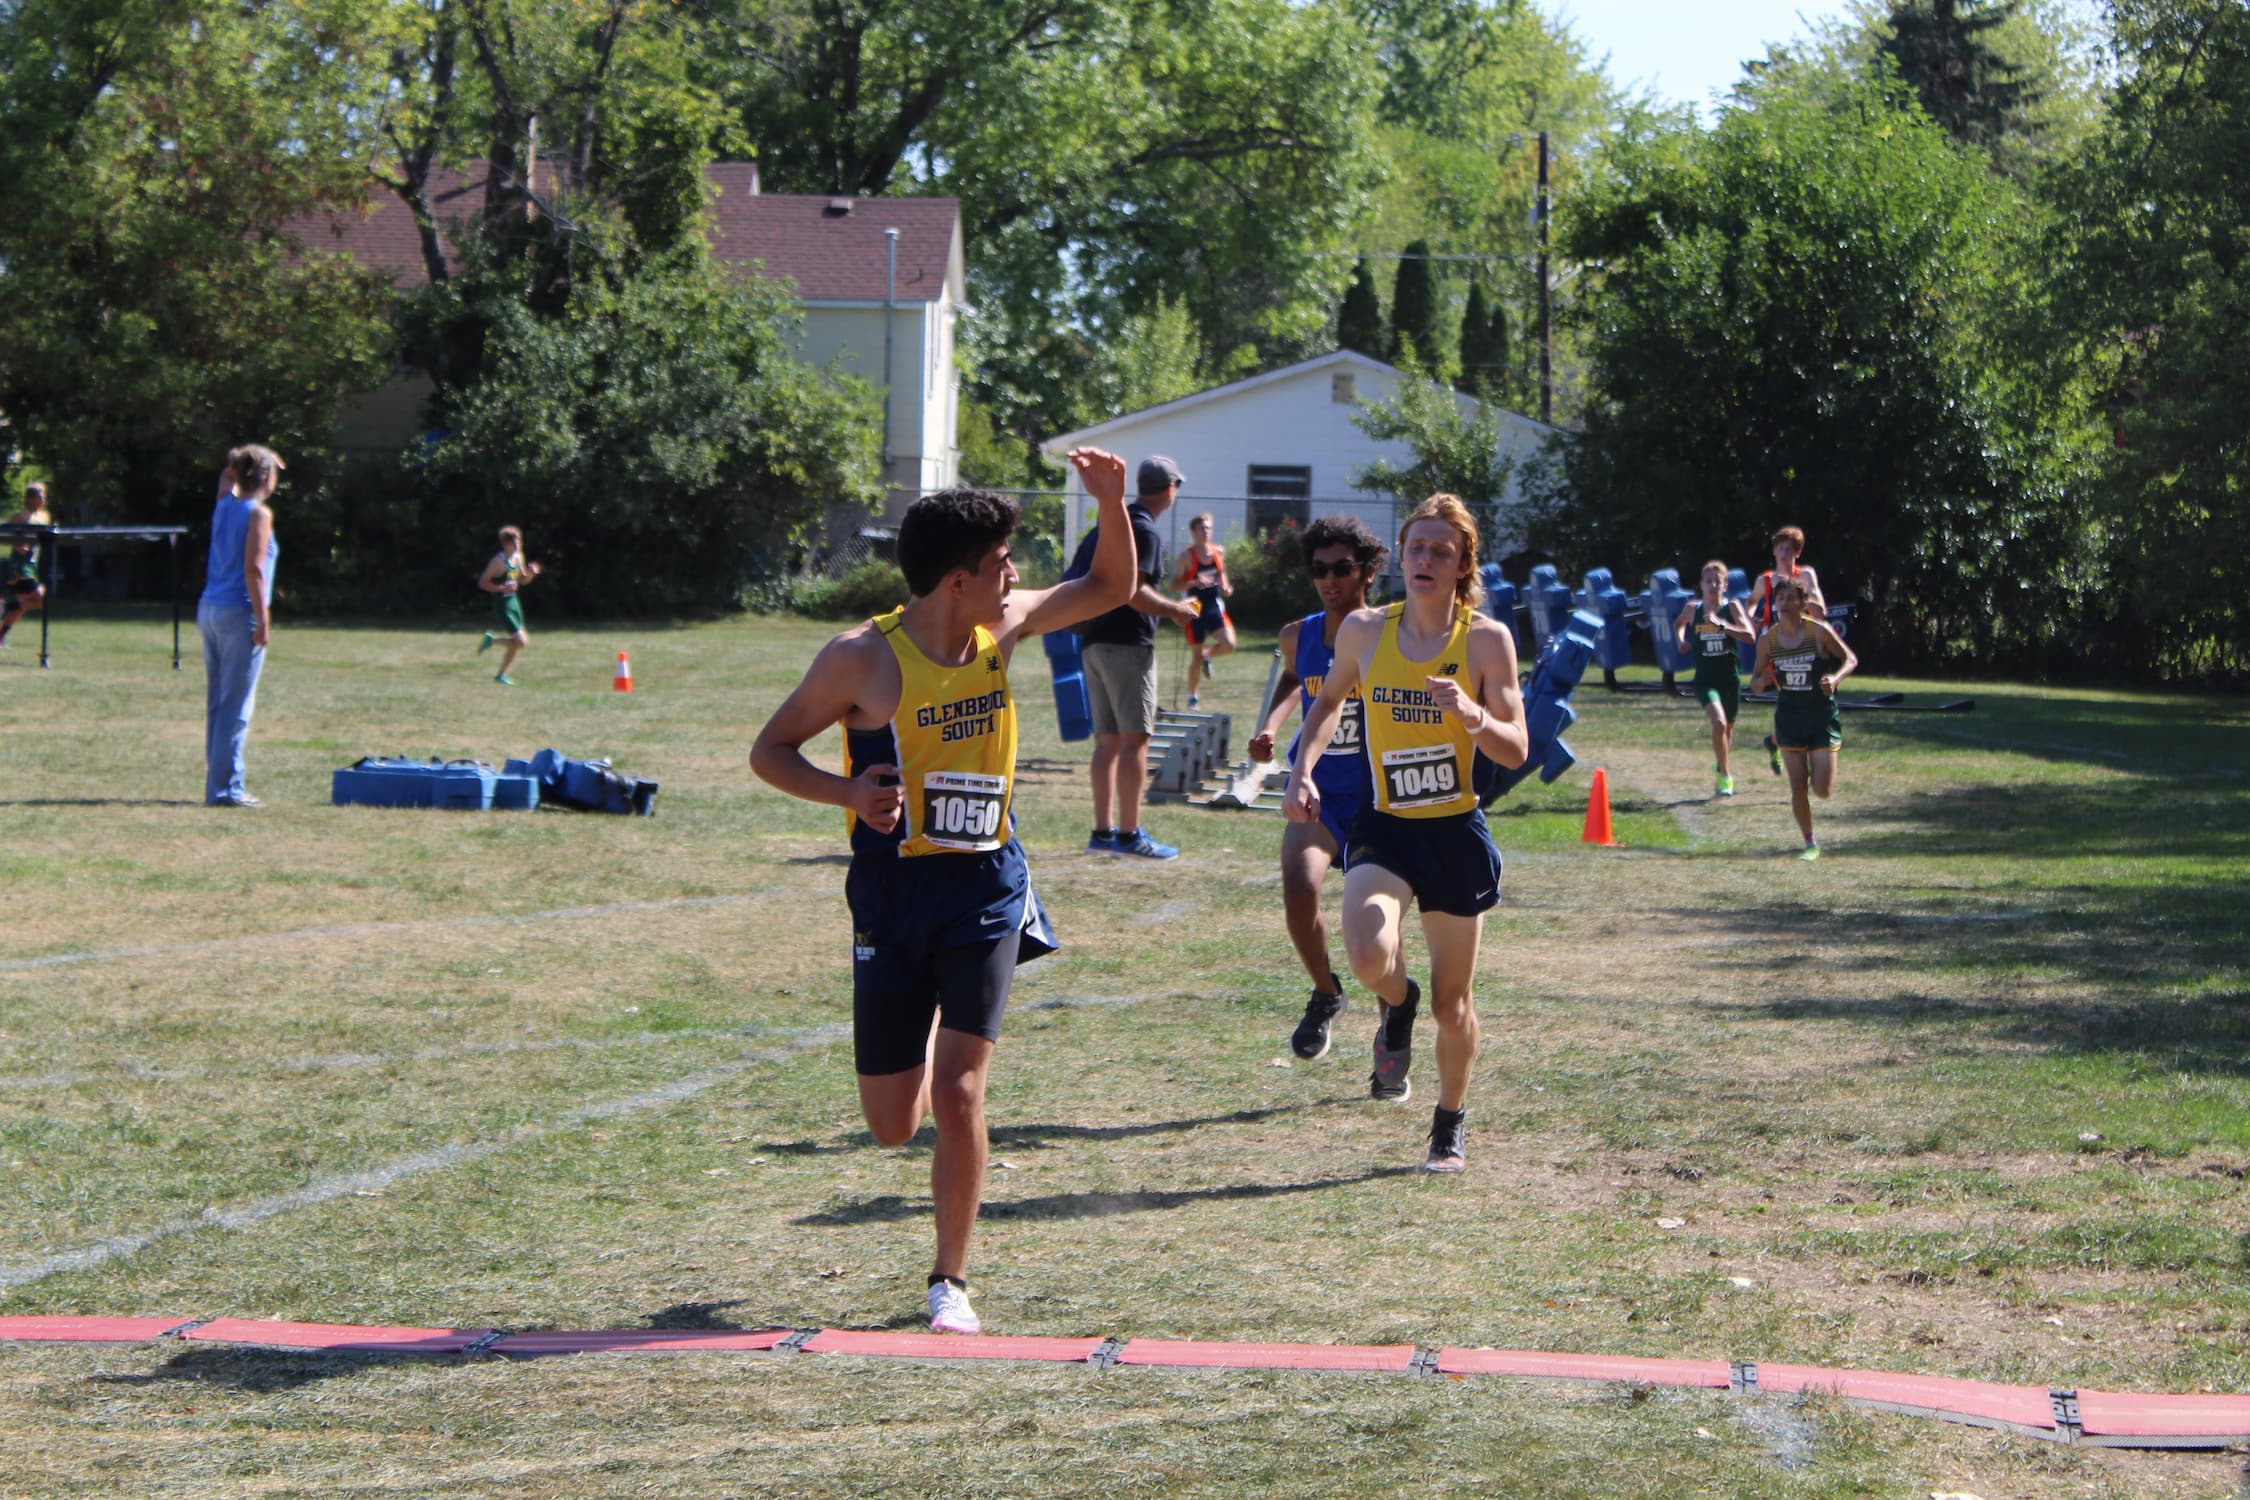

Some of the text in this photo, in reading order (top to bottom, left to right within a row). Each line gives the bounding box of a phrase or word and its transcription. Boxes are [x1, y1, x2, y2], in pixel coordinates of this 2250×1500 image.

[1785, 672, 1807, 685] 927
[1392, 707, 1443, 725] SOUTH
[945, 777, 966, 787] PRIME
[967, 779, 983, 788] TIME
[1390, 763, 1455, 797] 1049
[930, 796, 1000, 837] 1050
